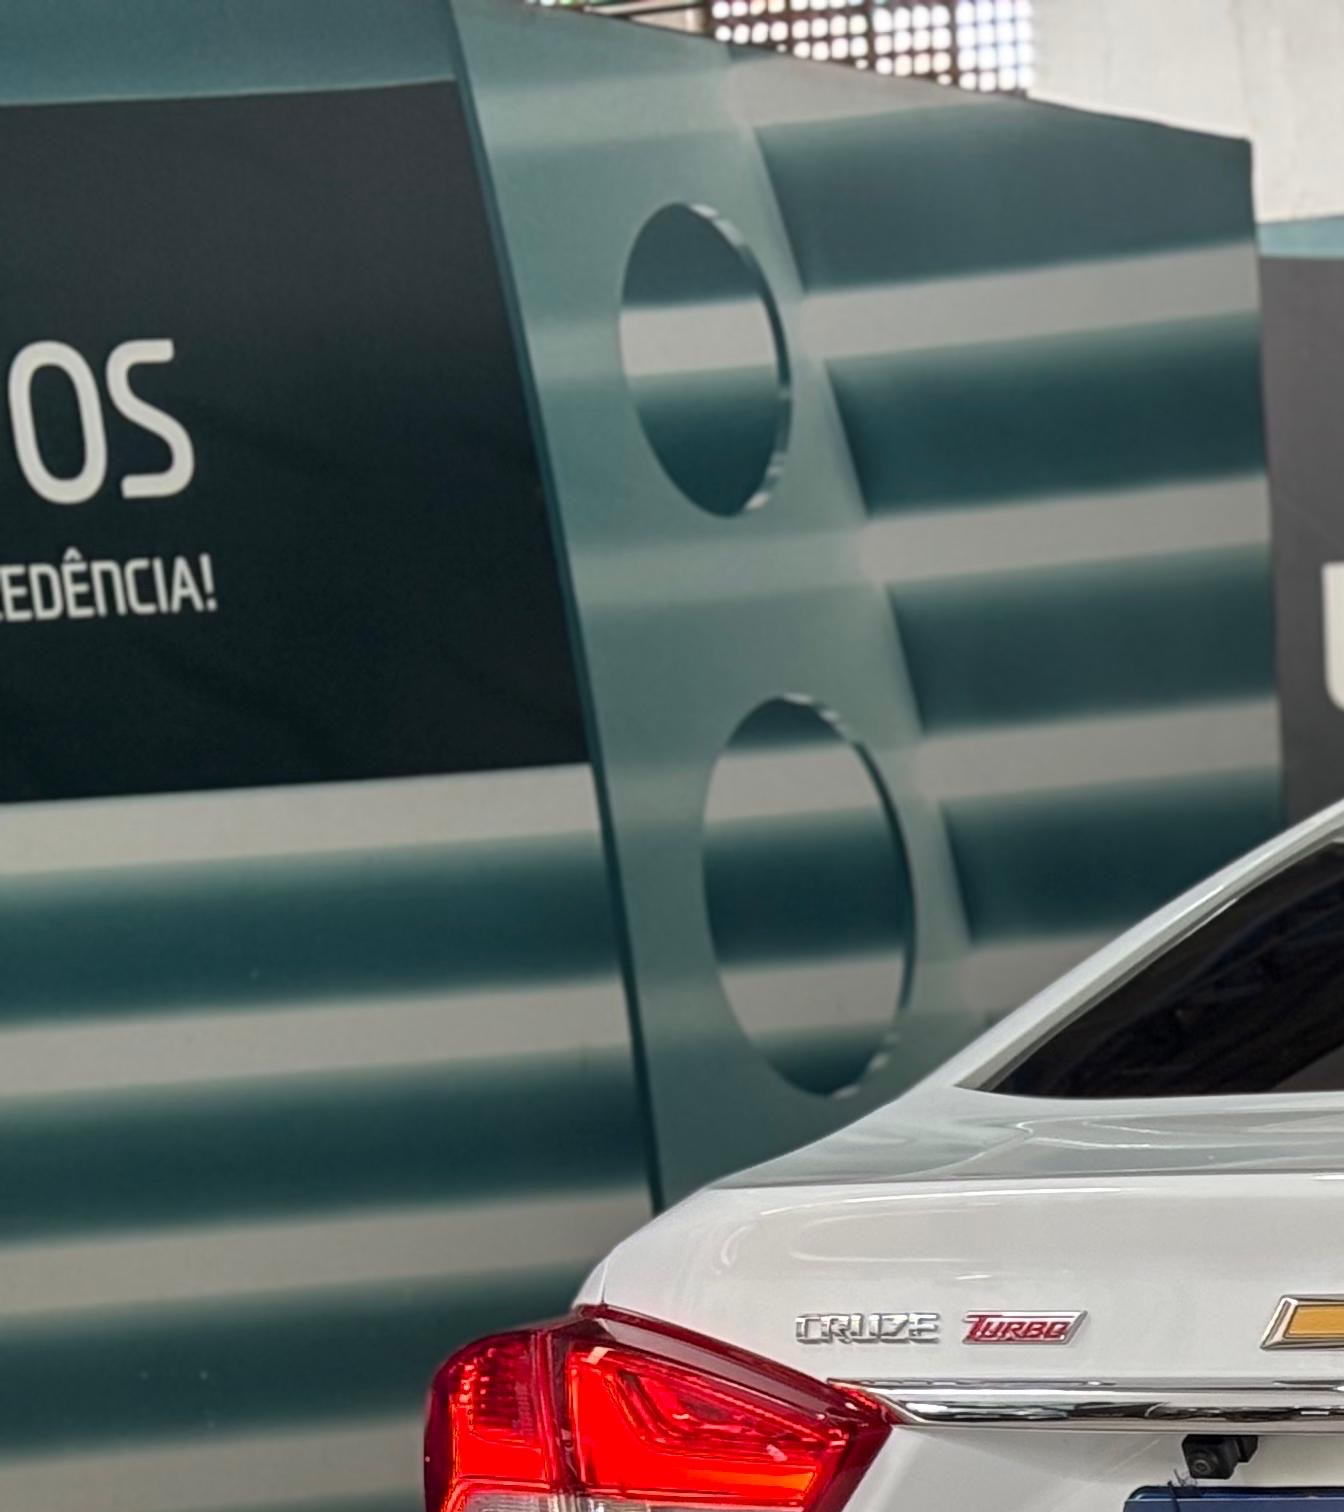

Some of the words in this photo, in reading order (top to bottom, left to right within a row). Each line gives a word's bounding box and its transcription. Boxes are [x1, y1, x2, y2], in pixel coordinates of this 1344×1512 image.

[8, 337, 195, 504] OS
[0, 546, 217, 621] EDÊNCIA!
[796, 1312, 940, 1344] CRUZE
[964, 1313, 1068, 1341] TURBO
